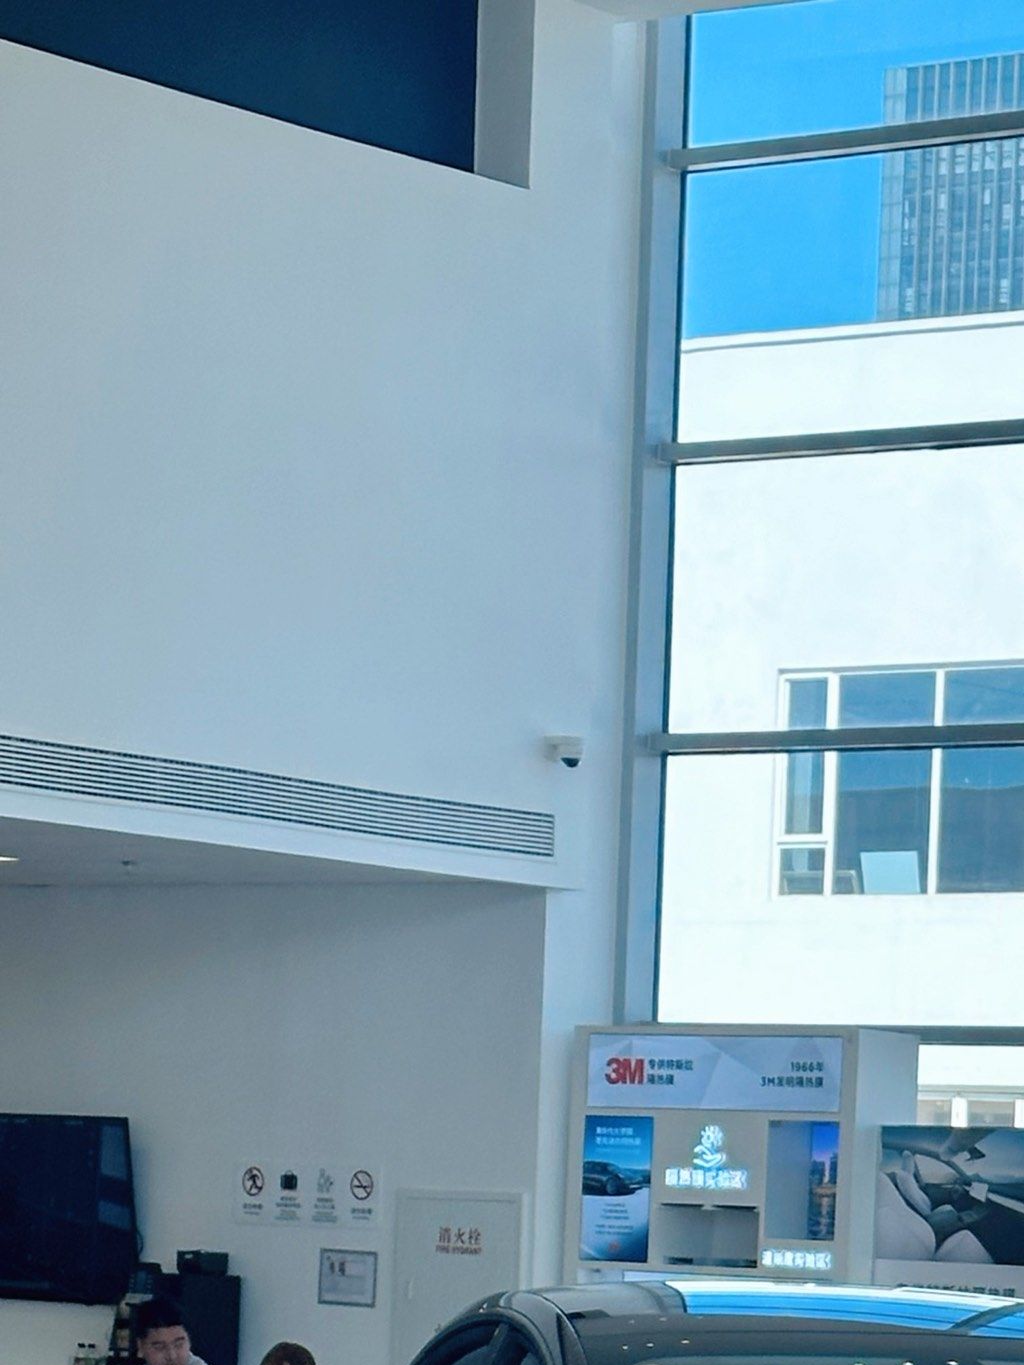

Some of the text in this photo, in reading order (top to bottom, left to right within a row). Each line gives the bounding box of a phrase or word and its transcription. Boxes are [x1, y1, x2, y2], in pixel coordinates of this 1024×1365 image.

[605, 1057, 645, 1085] 3M
[438, 1226, 481, 1245] 消火栓
